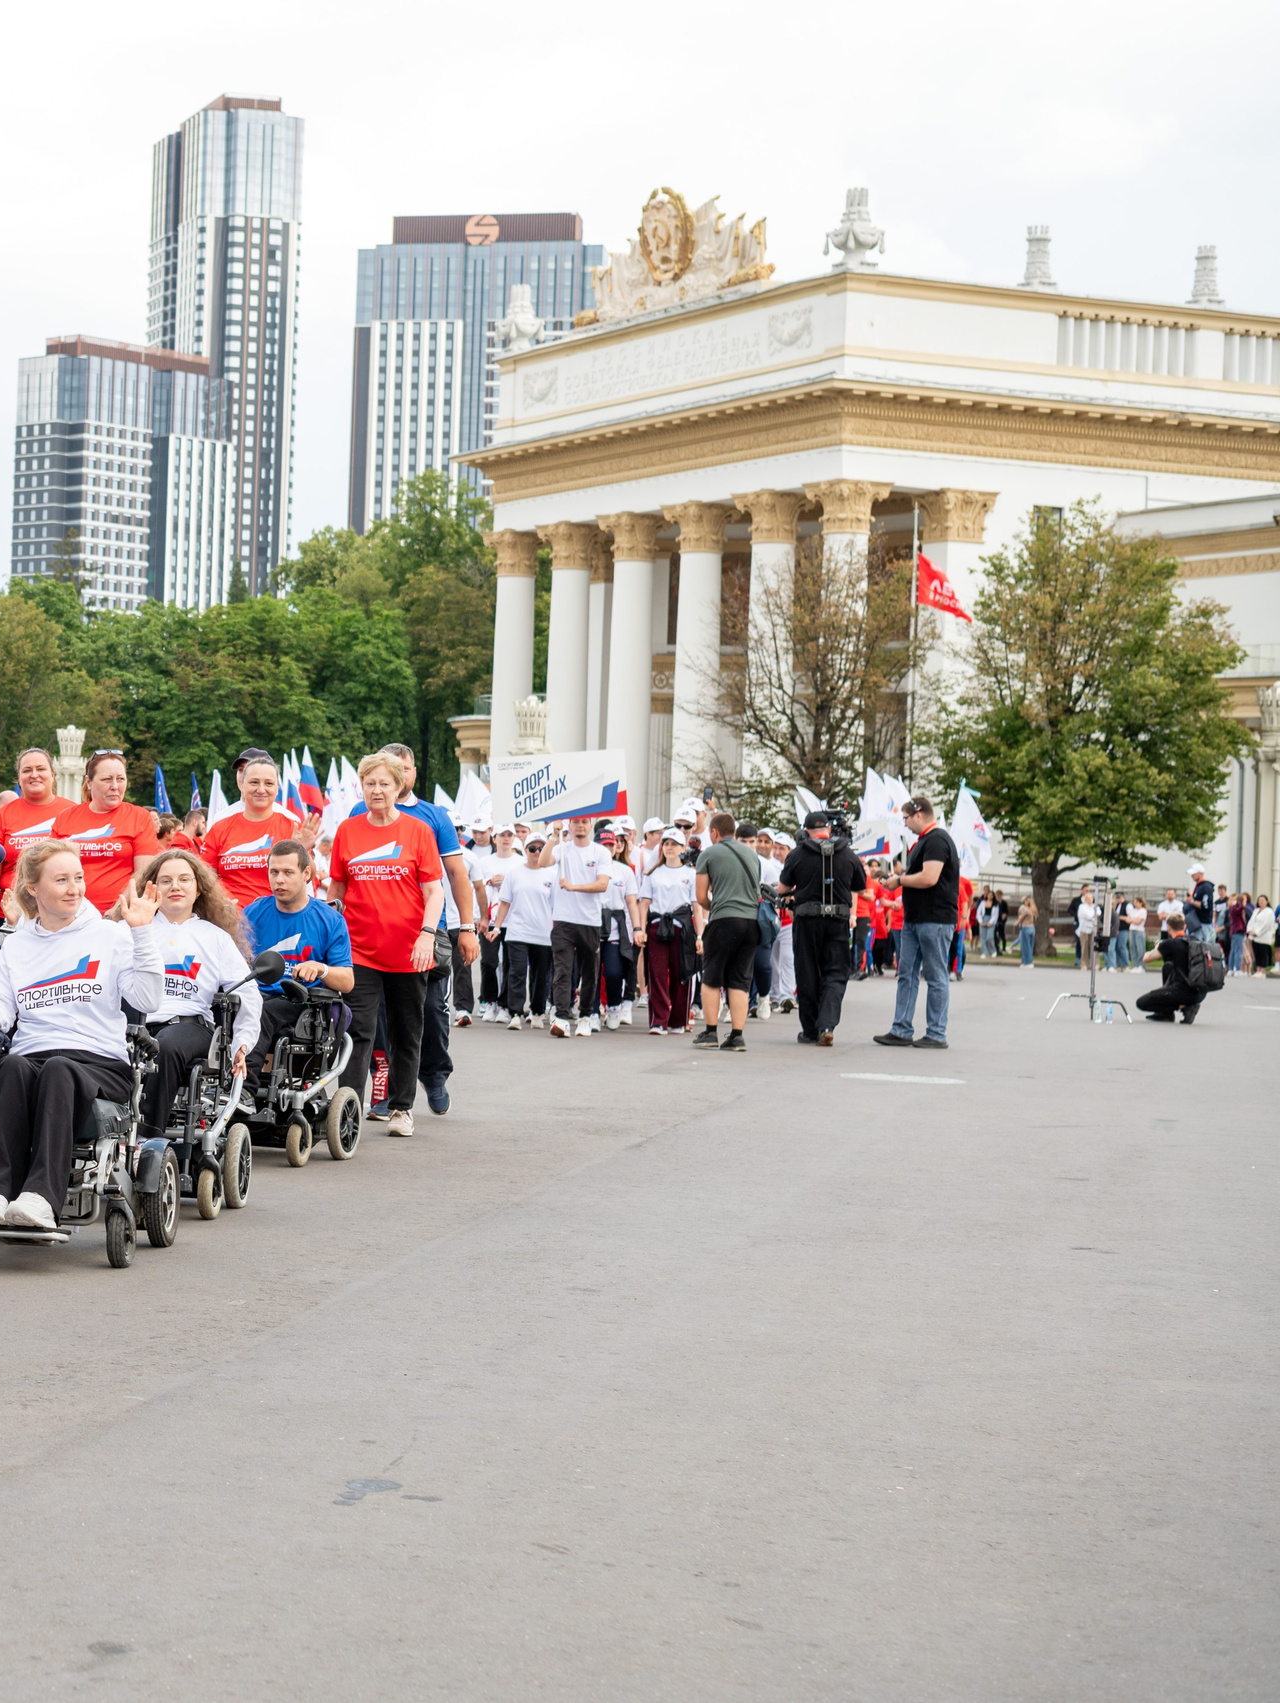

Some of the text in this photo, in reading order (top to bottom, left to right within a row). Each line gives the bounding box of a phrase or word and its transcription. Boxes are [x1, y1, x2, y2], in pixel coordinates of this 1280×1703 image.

[513, 763, 551, 799] СПОРТ
[514, 774, 567, 818] СЛЕПЫХ
[224, 862, 269, 871] ШЕСТВИ
[24, 995, 92, 1011] ШЕСТВИЕ
